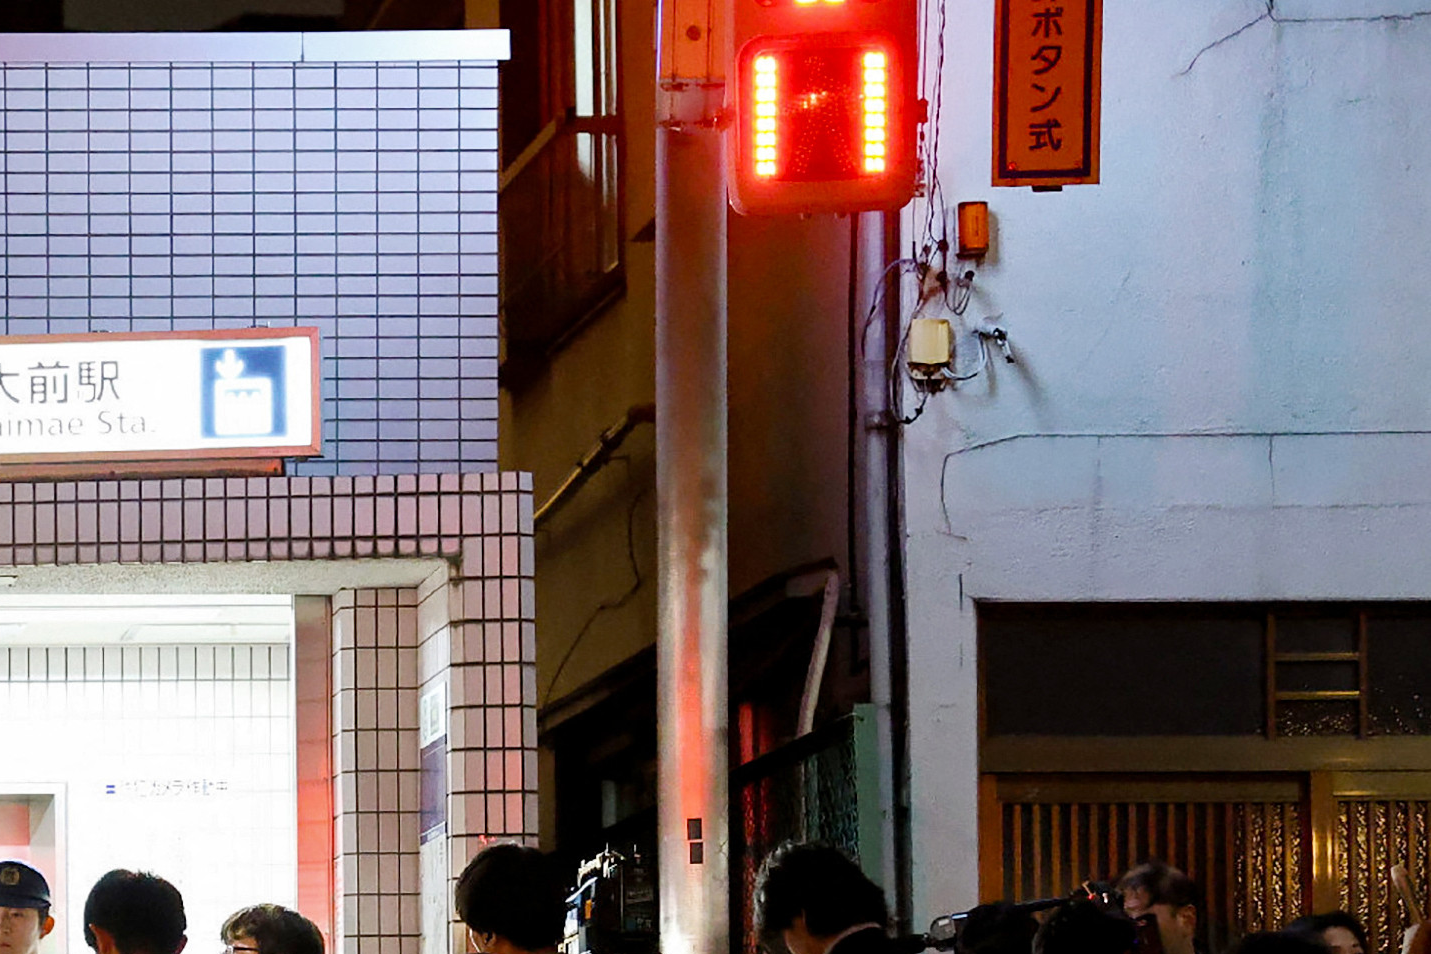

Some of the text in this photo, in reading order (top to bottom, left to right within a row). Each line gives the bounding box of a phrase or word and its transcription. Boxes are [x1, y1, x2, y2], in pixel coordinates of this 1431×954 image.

[1028, 0, 1064, 151] ボタン式
[98, 410, 157, 434] Sta.
